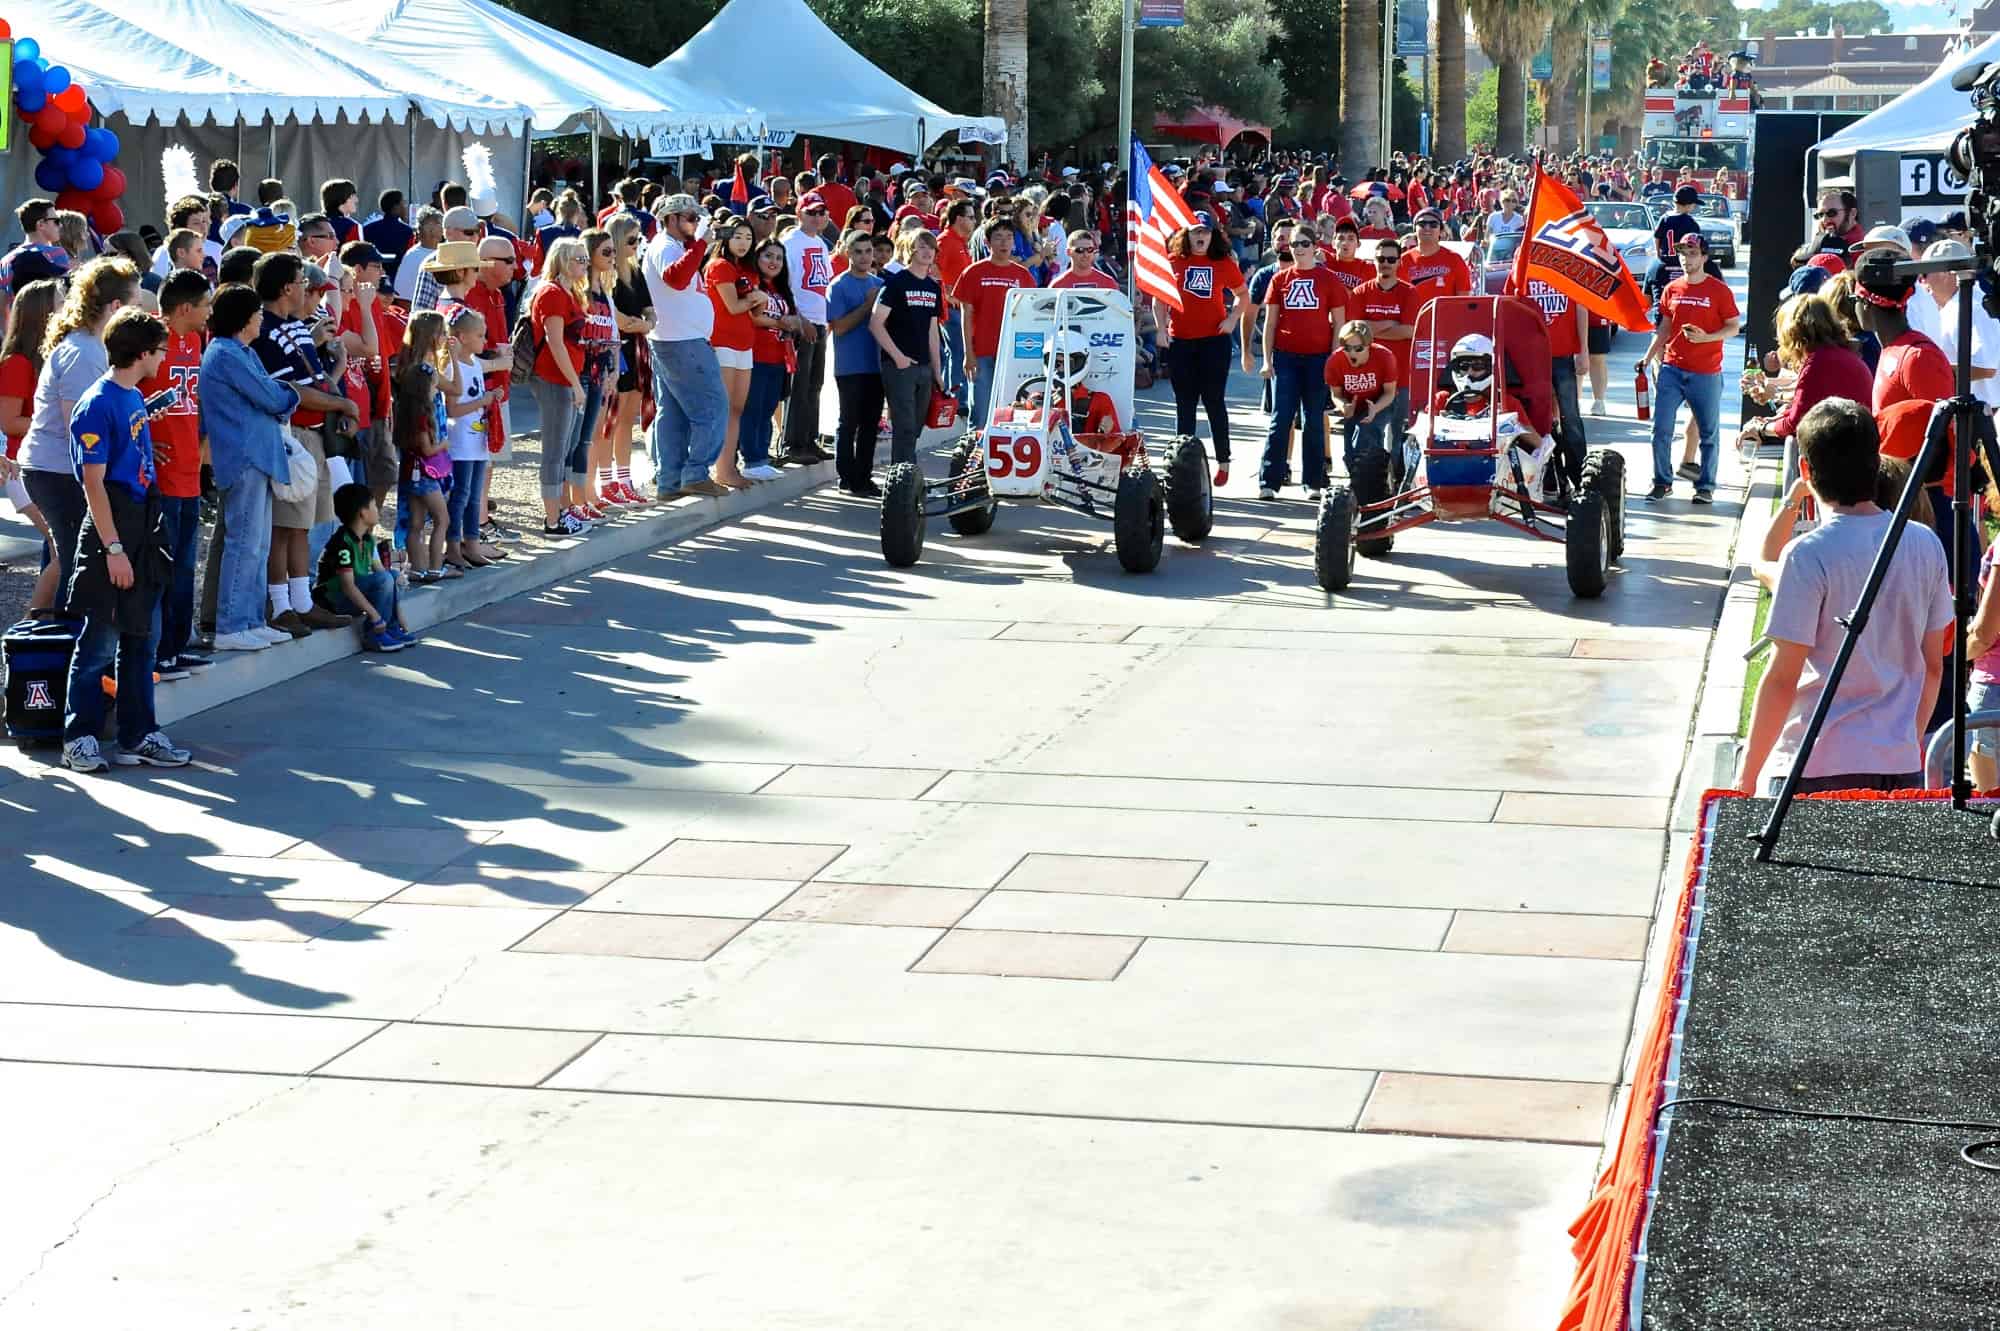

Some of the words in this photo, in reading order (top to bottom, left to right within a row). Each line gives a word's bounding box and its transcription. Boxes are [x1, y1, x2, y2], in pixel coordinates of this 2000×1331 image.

[1911, 163, 1926, 192] f
[1530, 241, 1618, 299] RIZONA
[1284, 279, 1319, 309] A
[1535, 295, 1568, 314] OWN
[1089, 332, 1125, 347] SAE
[1343, 372, 1376, 384] BEAR
[1344, 379, 1377, 391] DOWN
[988, 435, 1042, 478] 59
[338, 549, 351, 565] 3
[24, 680, 56, 710] A
